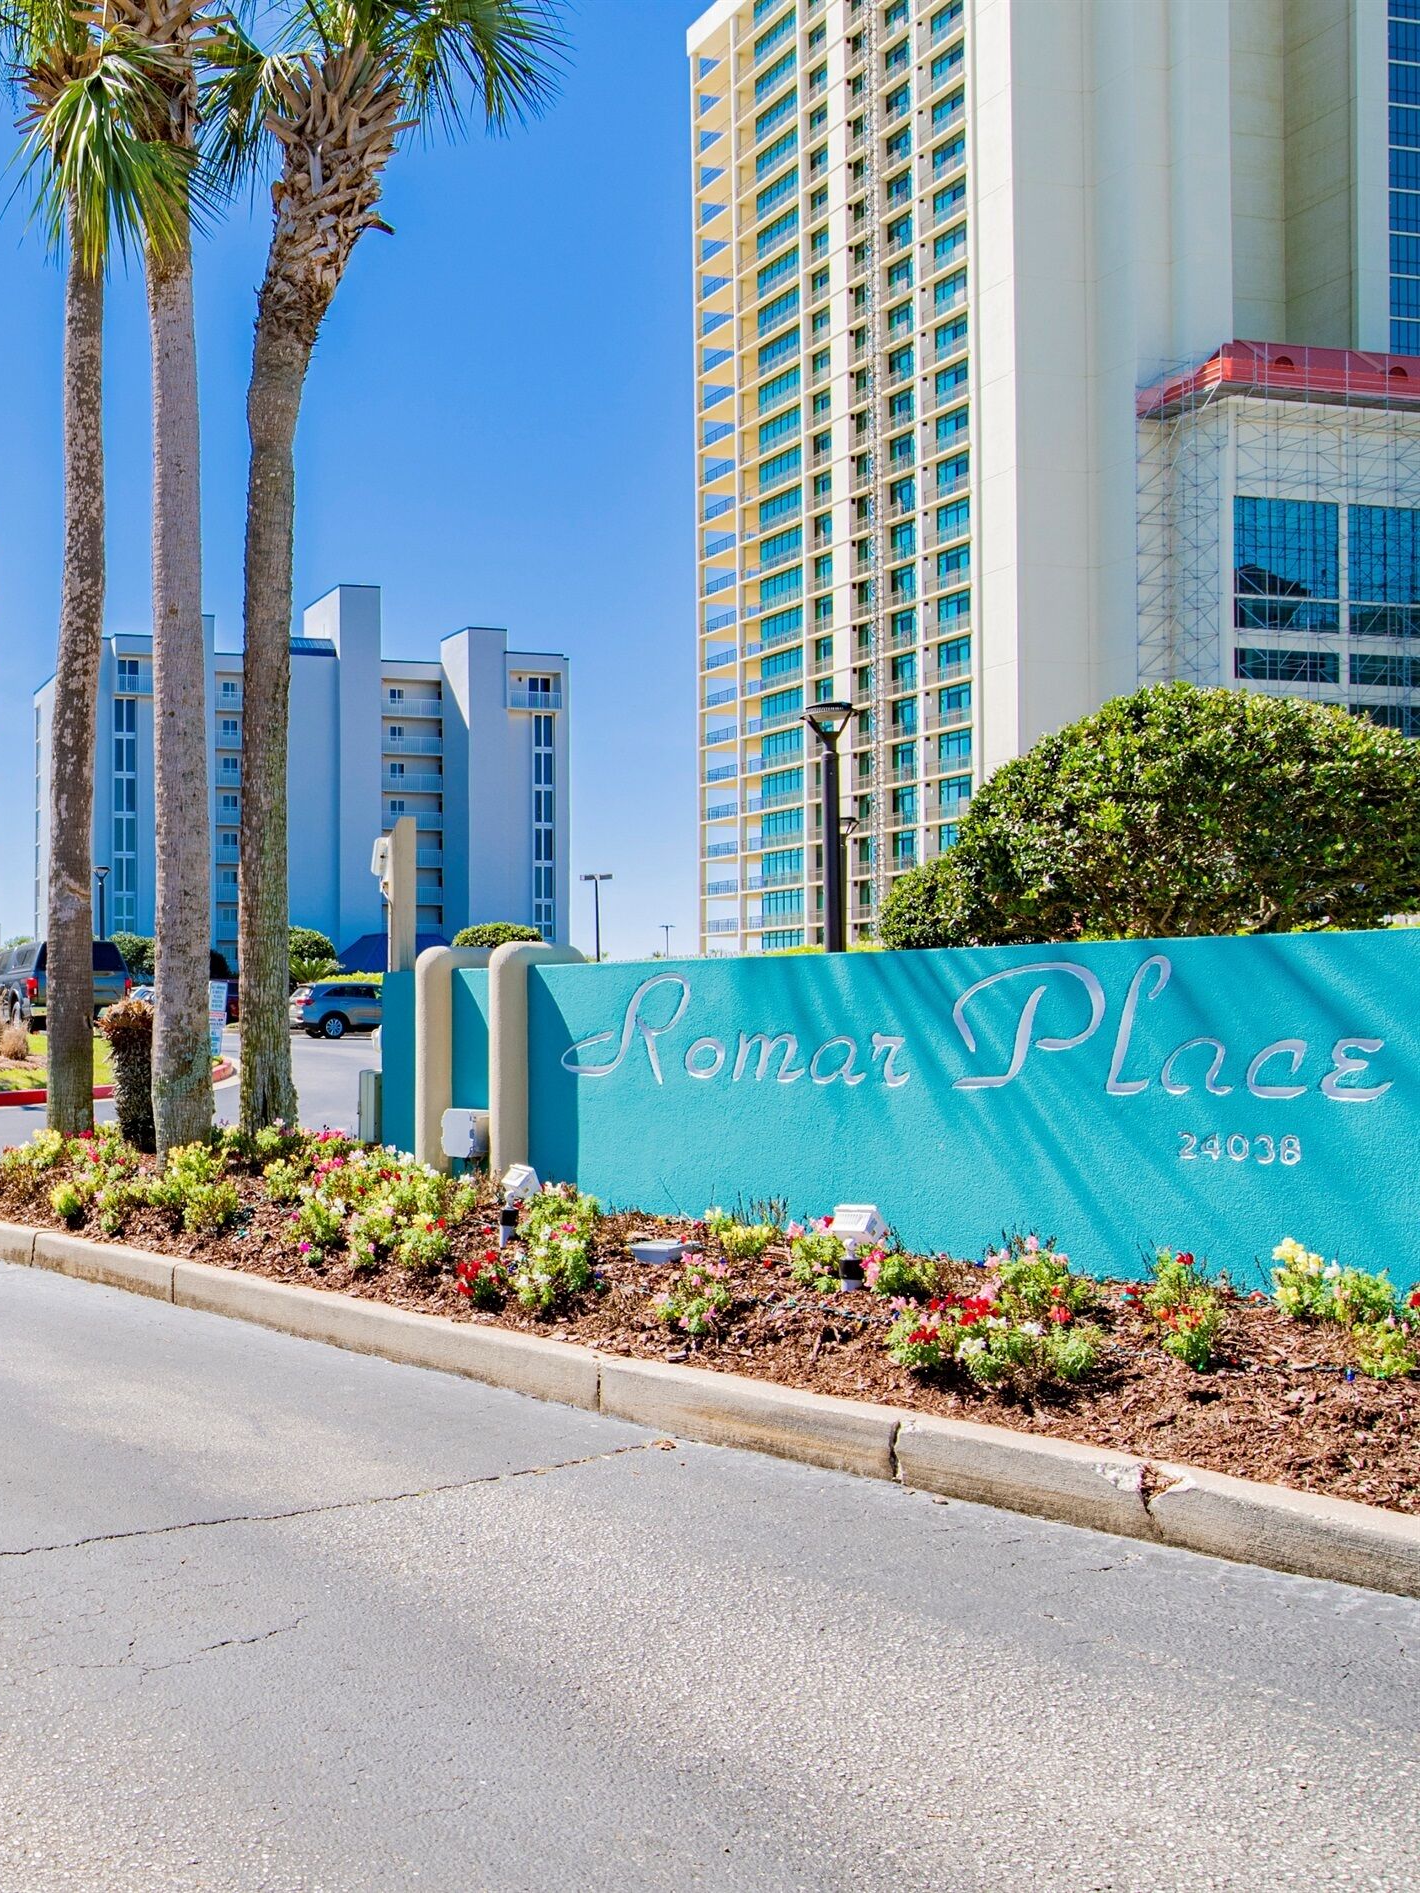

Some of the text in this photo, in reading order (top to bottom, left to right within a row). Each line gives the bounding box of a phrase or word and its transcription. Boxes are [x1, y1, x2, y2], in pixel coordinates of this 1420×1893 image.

[562, 955, 1394, 1102] Romar Place
[1178, 1131, 1301, 1165] 24038
